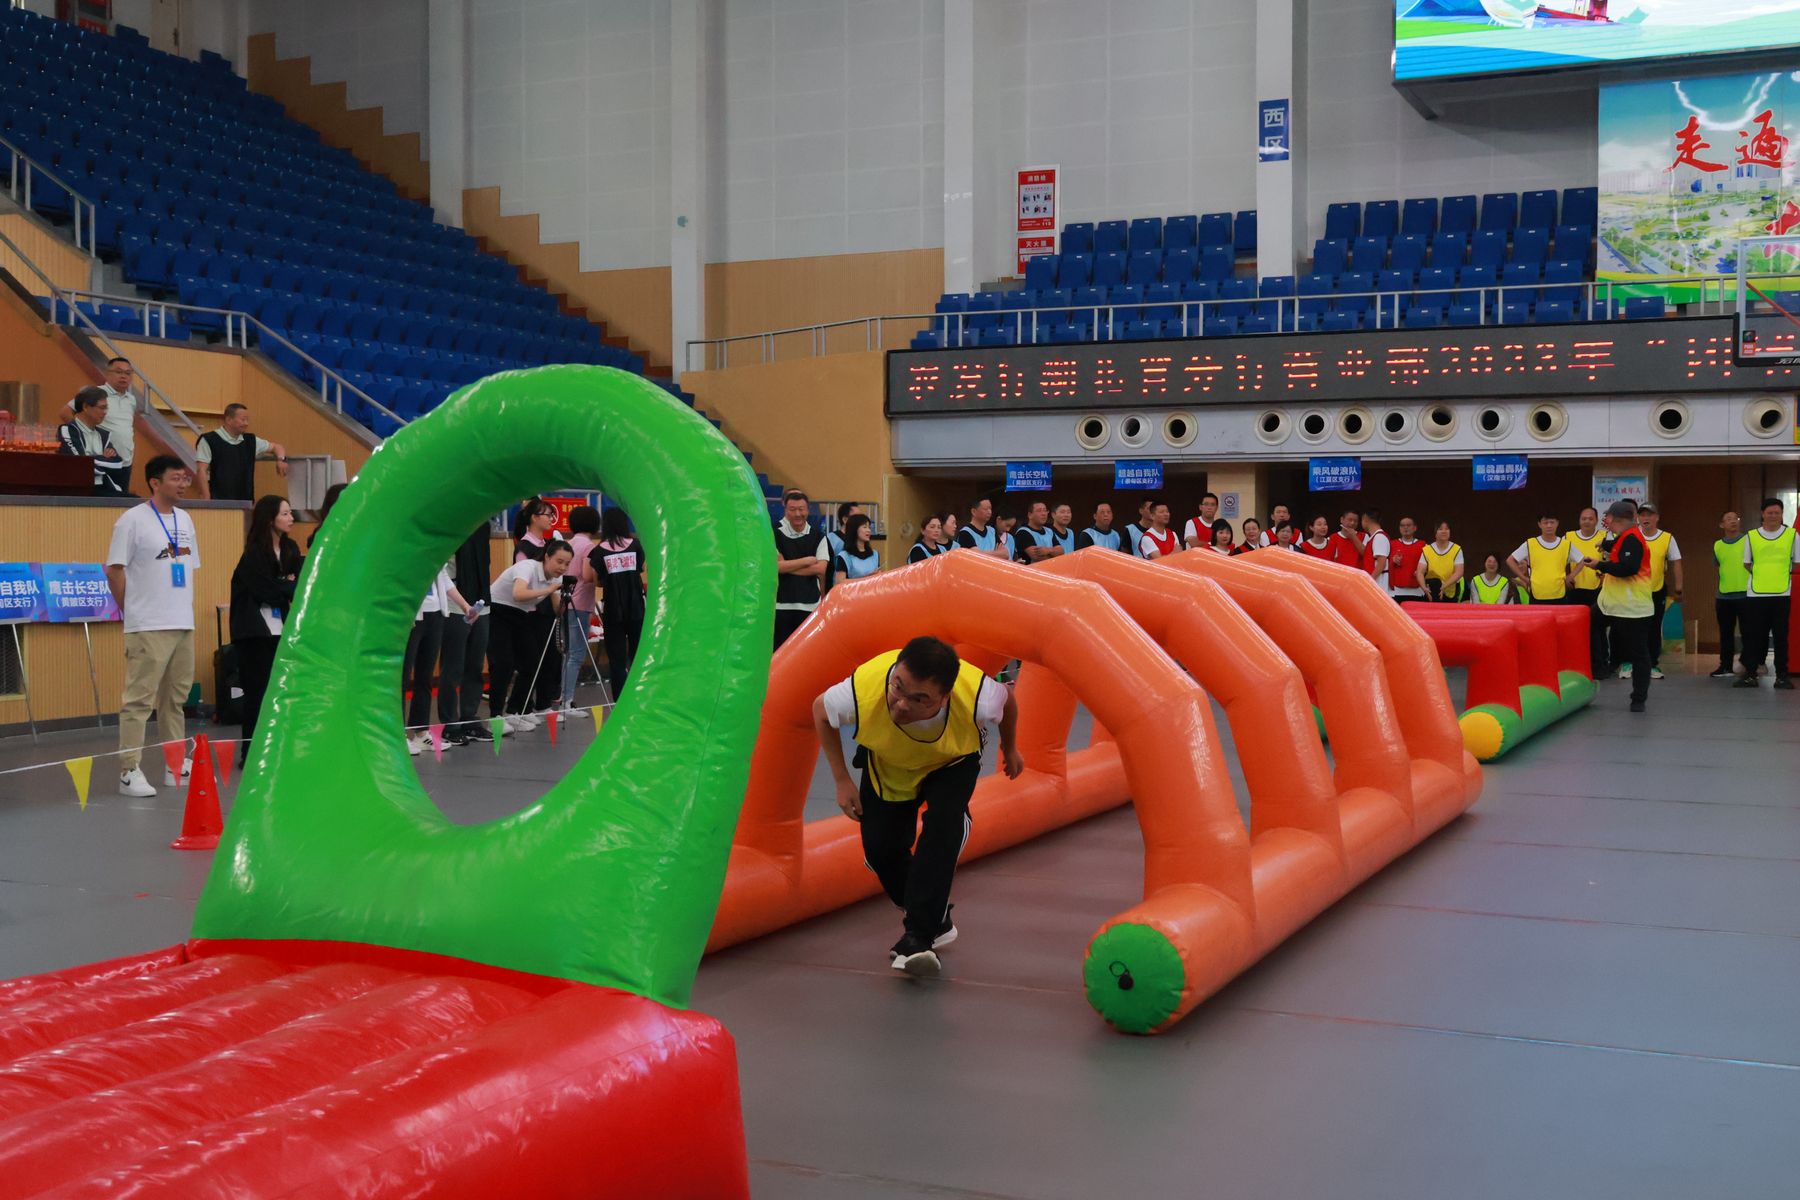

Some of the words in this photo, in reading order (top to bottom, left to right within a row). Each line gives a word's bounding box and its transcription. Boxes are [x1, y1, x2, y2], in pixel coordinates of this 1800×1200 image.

[1263, 107, 1285, 155] 西区
[1663, 109, 1796, 173] 走遍
[1009, 470, 1049, 479] 鹰击长空队
[1118, 468, 1160, 478] 超越自我队
[1312, 466, 1358, 476] 乘风破浪队
[0, 580, 40, 596] 自我队
[49, 580, 112, 596] 鹰击长空队
